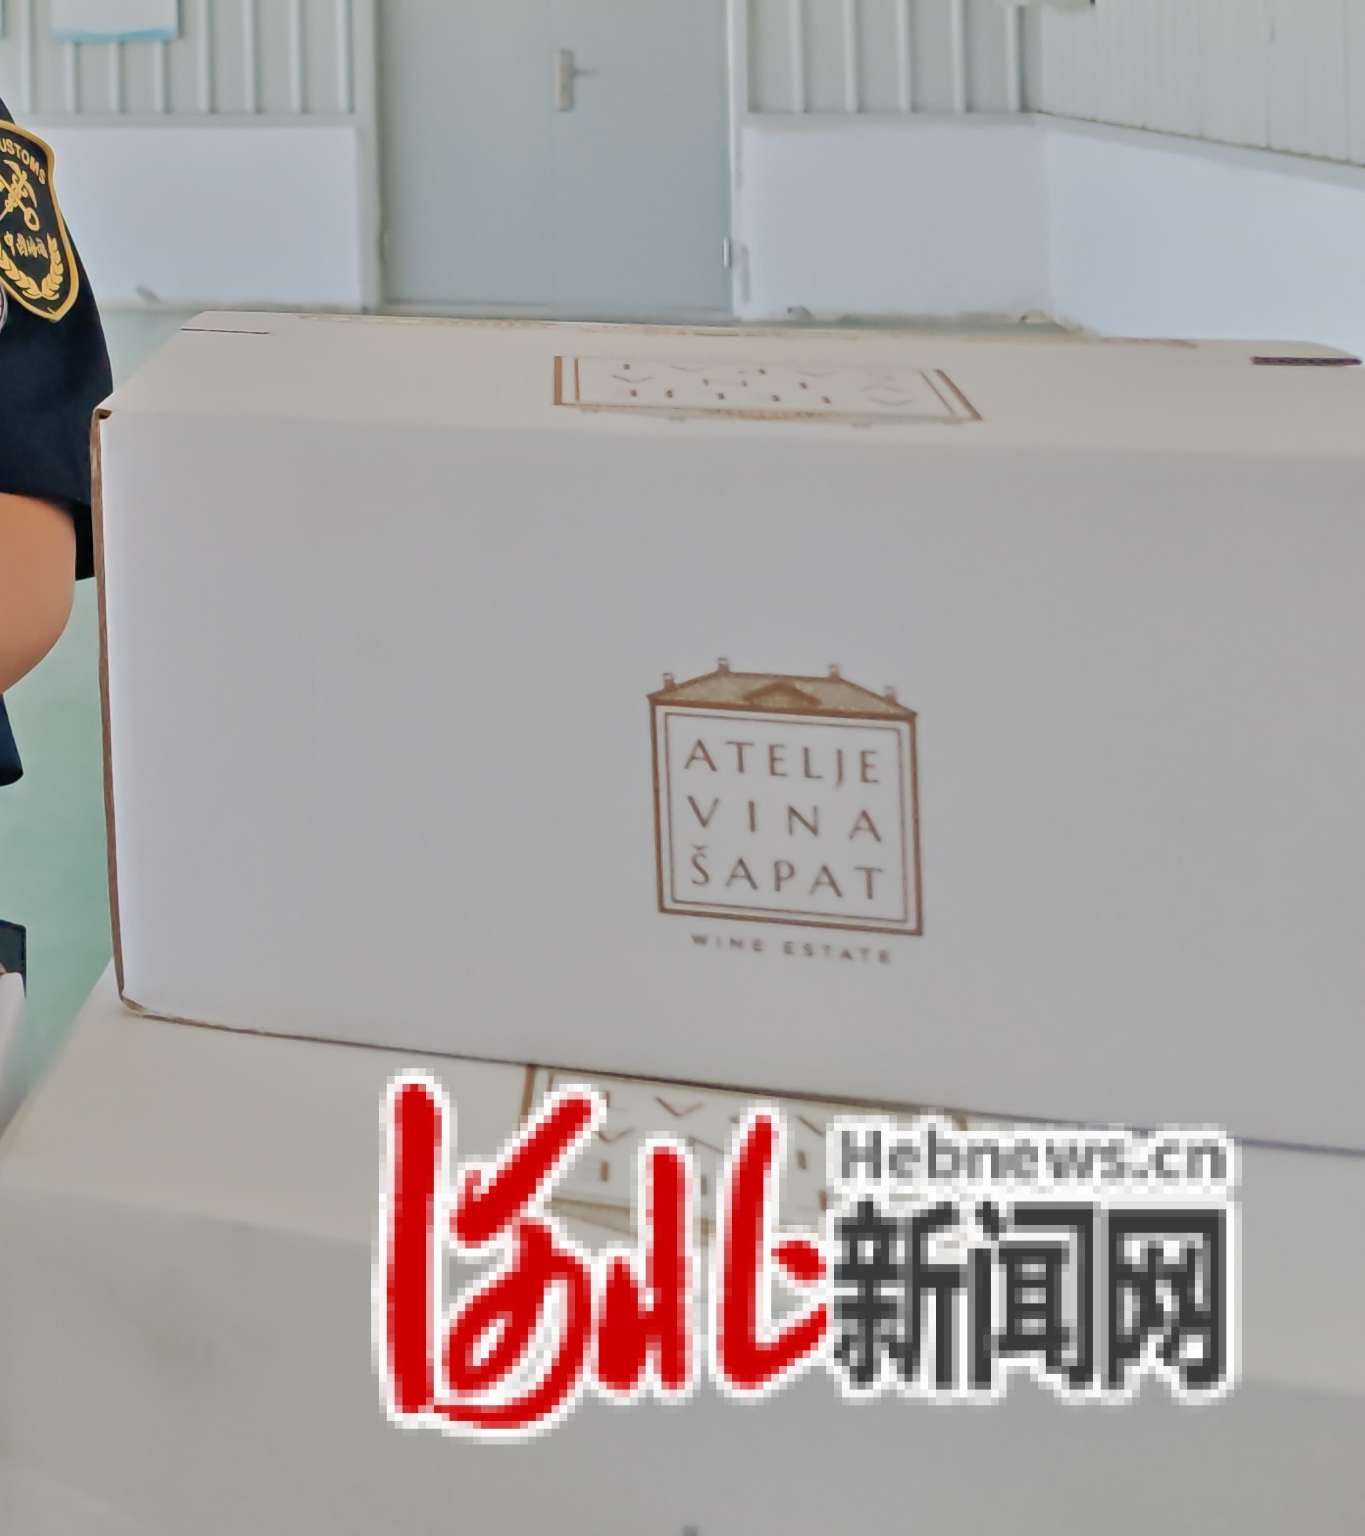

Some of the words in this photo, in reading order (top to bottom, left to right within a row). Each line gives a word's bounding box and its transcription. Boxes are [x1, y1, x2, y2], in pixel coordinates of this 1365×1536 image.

[683, 738, 880, 790] ATELJE
[686, 794, 882, 843] VINA
[689, 844, 884, 901] ŠAPAT
[690, 933, 764, 953] WINE
[782, 941, 891, 965] ESTATE
